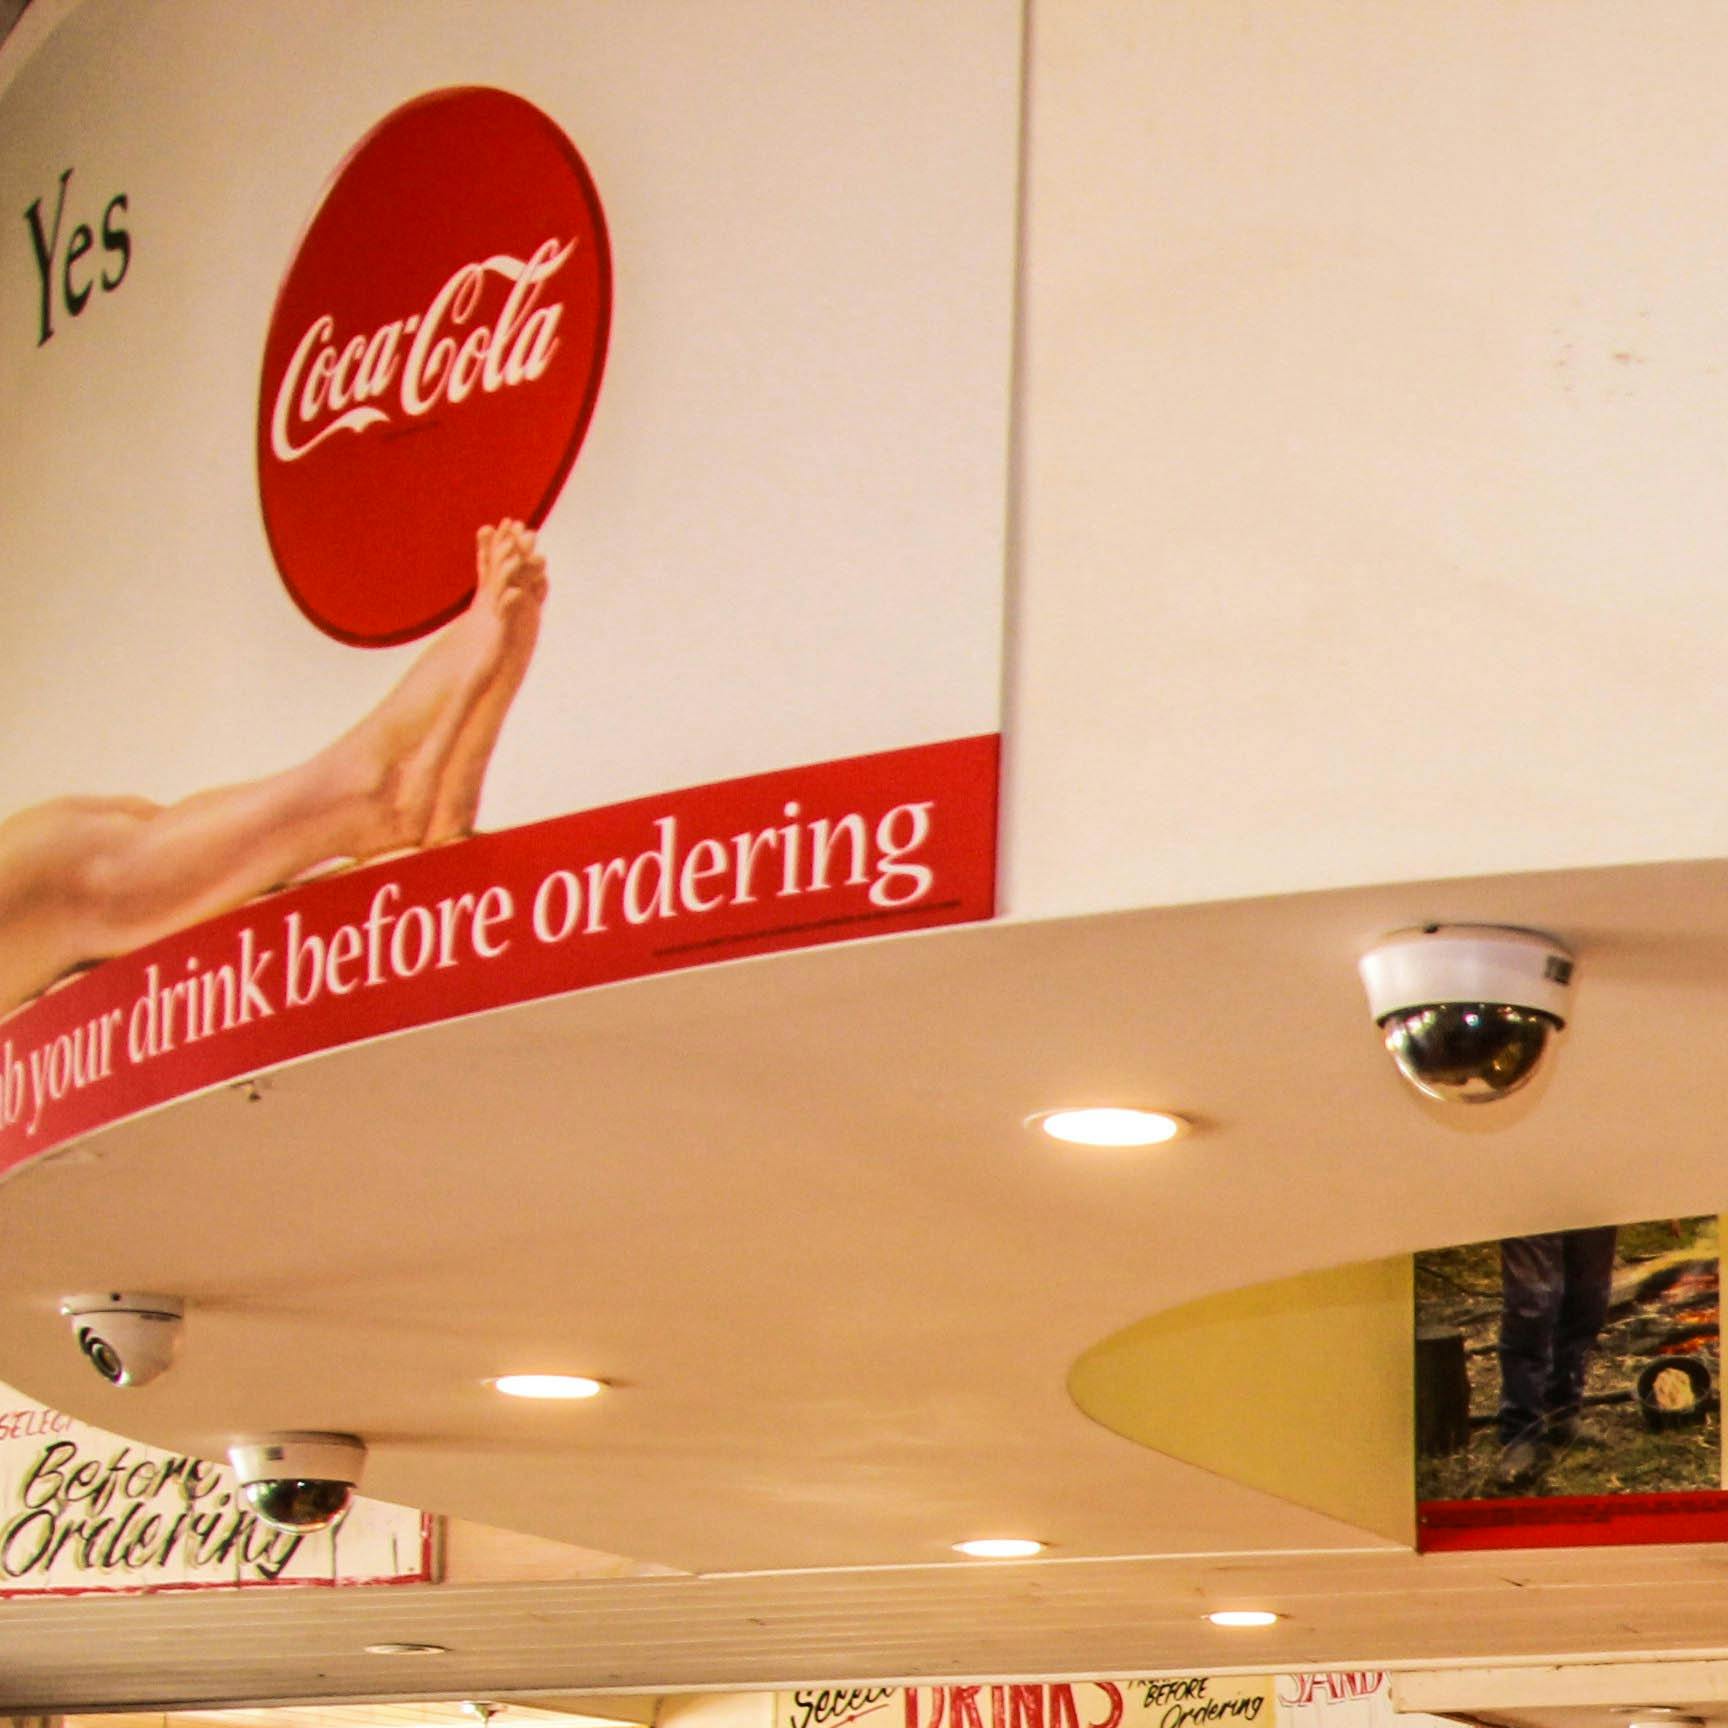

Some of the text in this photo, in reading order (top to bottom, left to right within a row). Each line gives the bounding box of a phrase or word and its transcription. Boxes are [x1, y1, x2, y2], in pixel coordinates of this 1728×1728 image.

[23, 169, 132, 347] Yes
[270, 236, 578, 463] Coca-Cola
[26, 799, 937, 1137] your drink before ordering
[24, 1440, 220, 1515] Before
[1144, 1677, 1209, 1708] BEFORE
